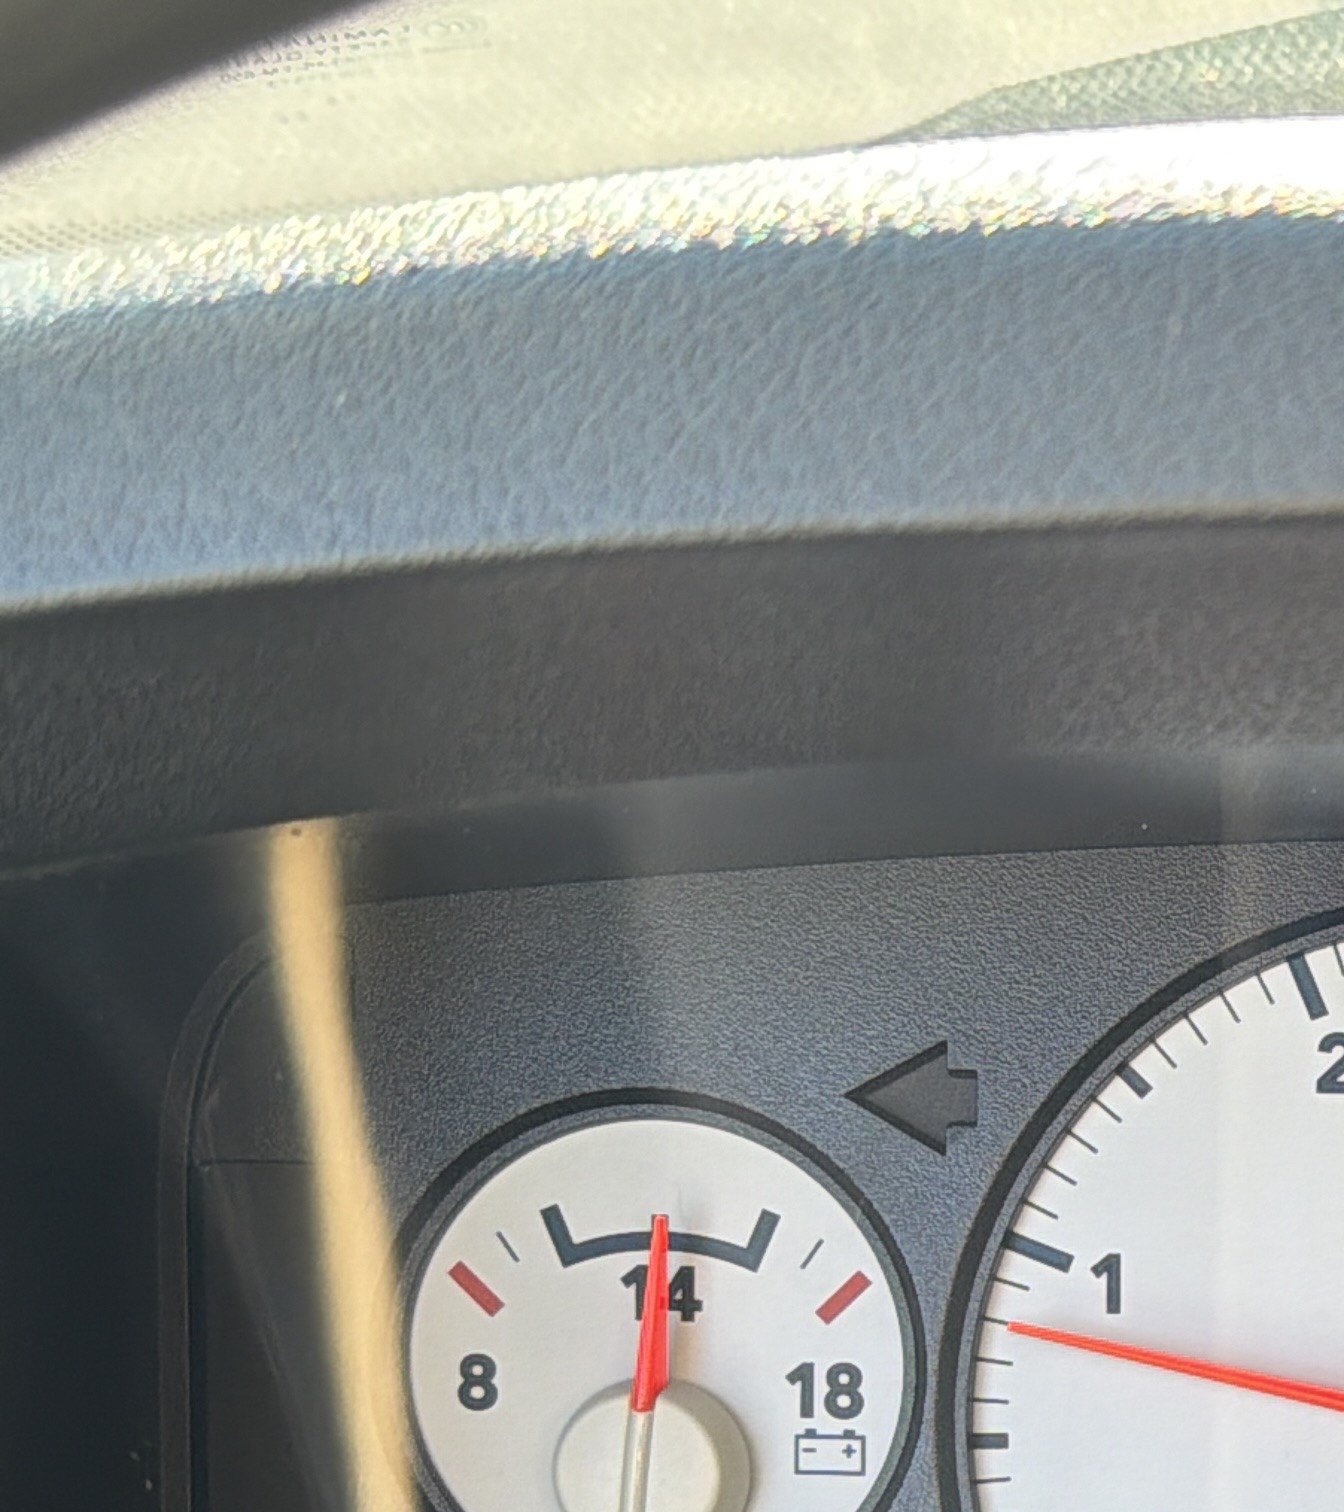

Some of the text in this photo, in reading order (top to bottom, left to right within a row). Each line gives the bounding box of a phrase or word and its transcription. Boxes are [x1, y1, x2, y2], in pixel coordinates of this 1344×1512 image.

[621, 1265, 703, 1322] 14
[1090, 1253, 1122, 1314] 1
[457, 1353, 498, 1411] 8
[785, 1361, 864, 1419] 18
